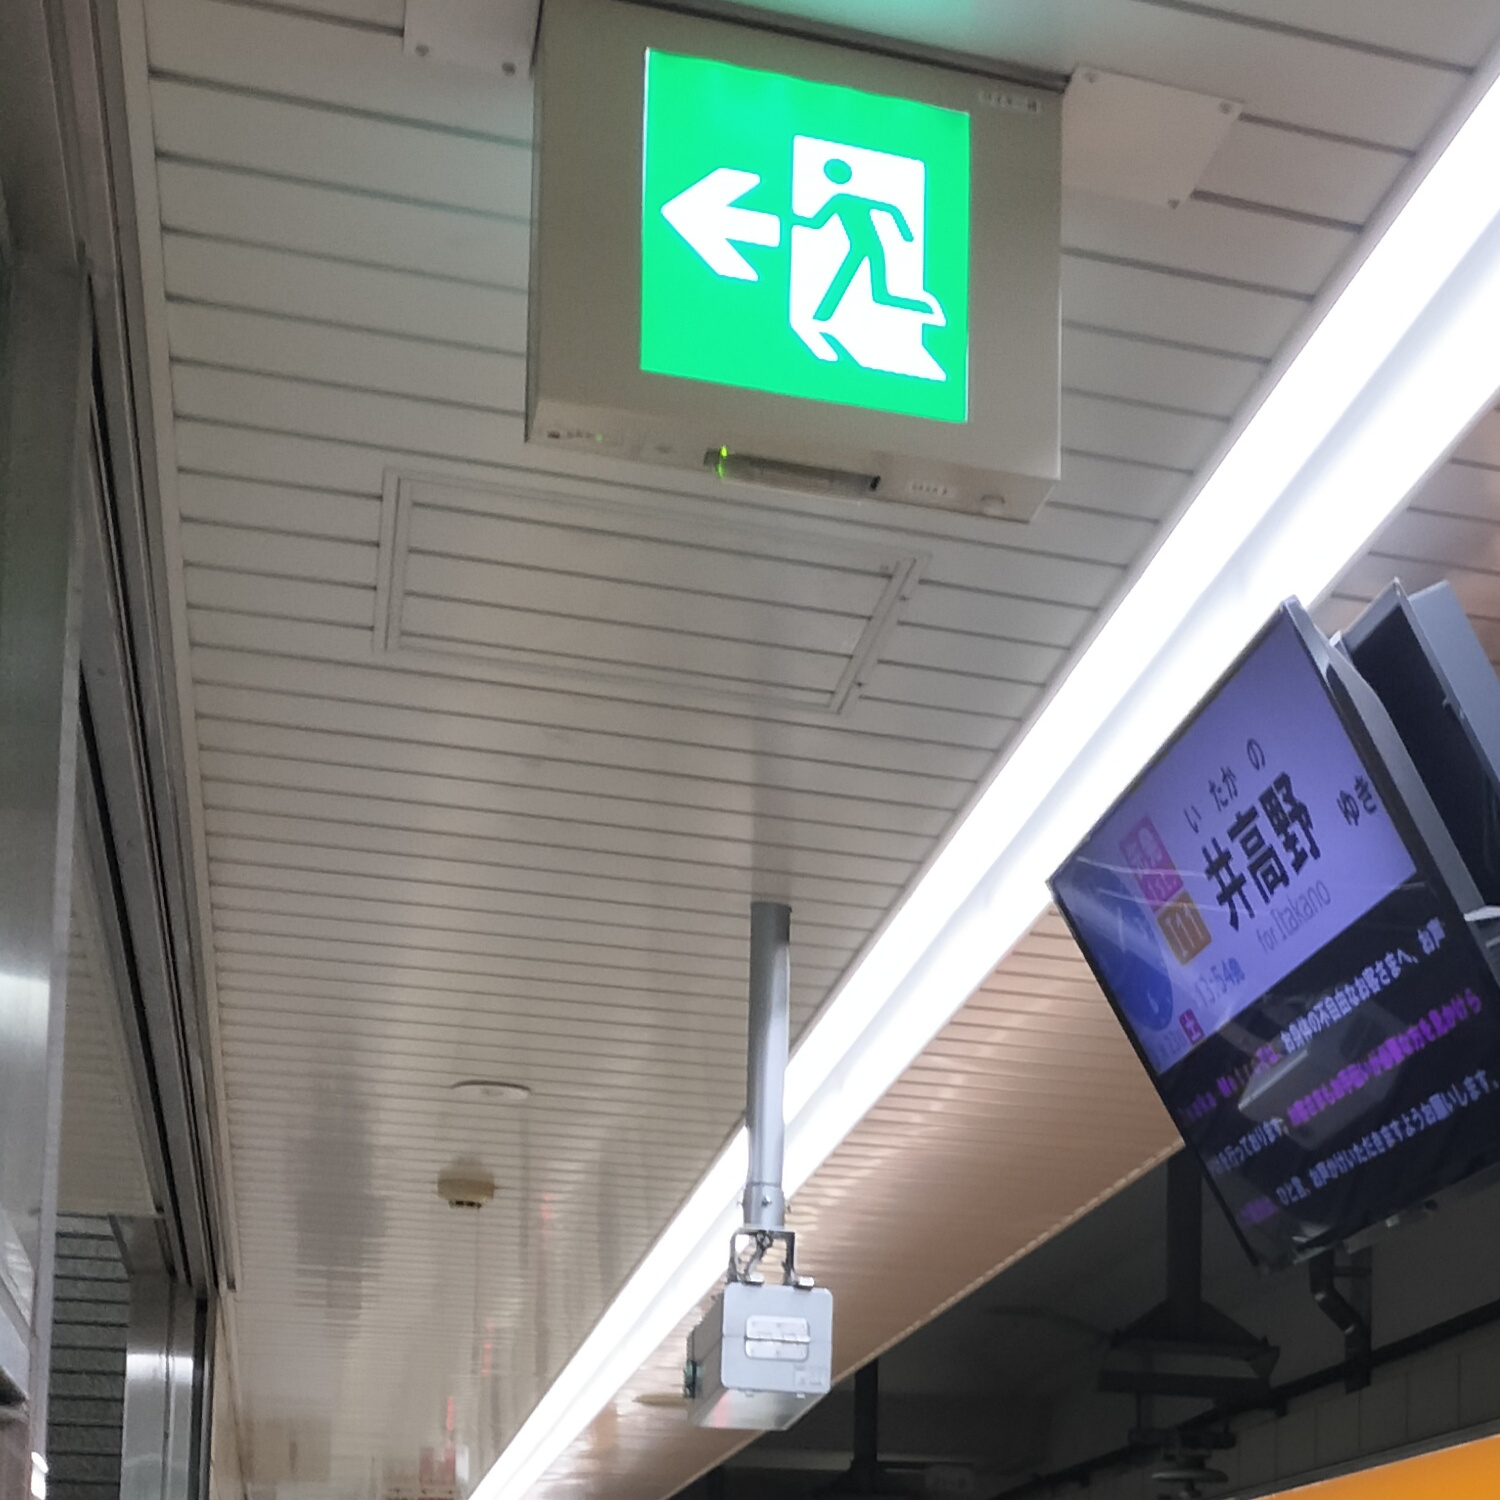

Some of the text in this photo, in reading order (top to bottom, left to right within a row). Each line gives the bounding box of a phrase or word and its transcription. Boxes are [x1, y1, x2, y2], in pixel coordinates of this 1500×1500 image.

[1337, 775, 1377, 827] ゆき
[1202, 772, 1321, 931] 井高野
[1270, 879, 1332, 942] Itakano
